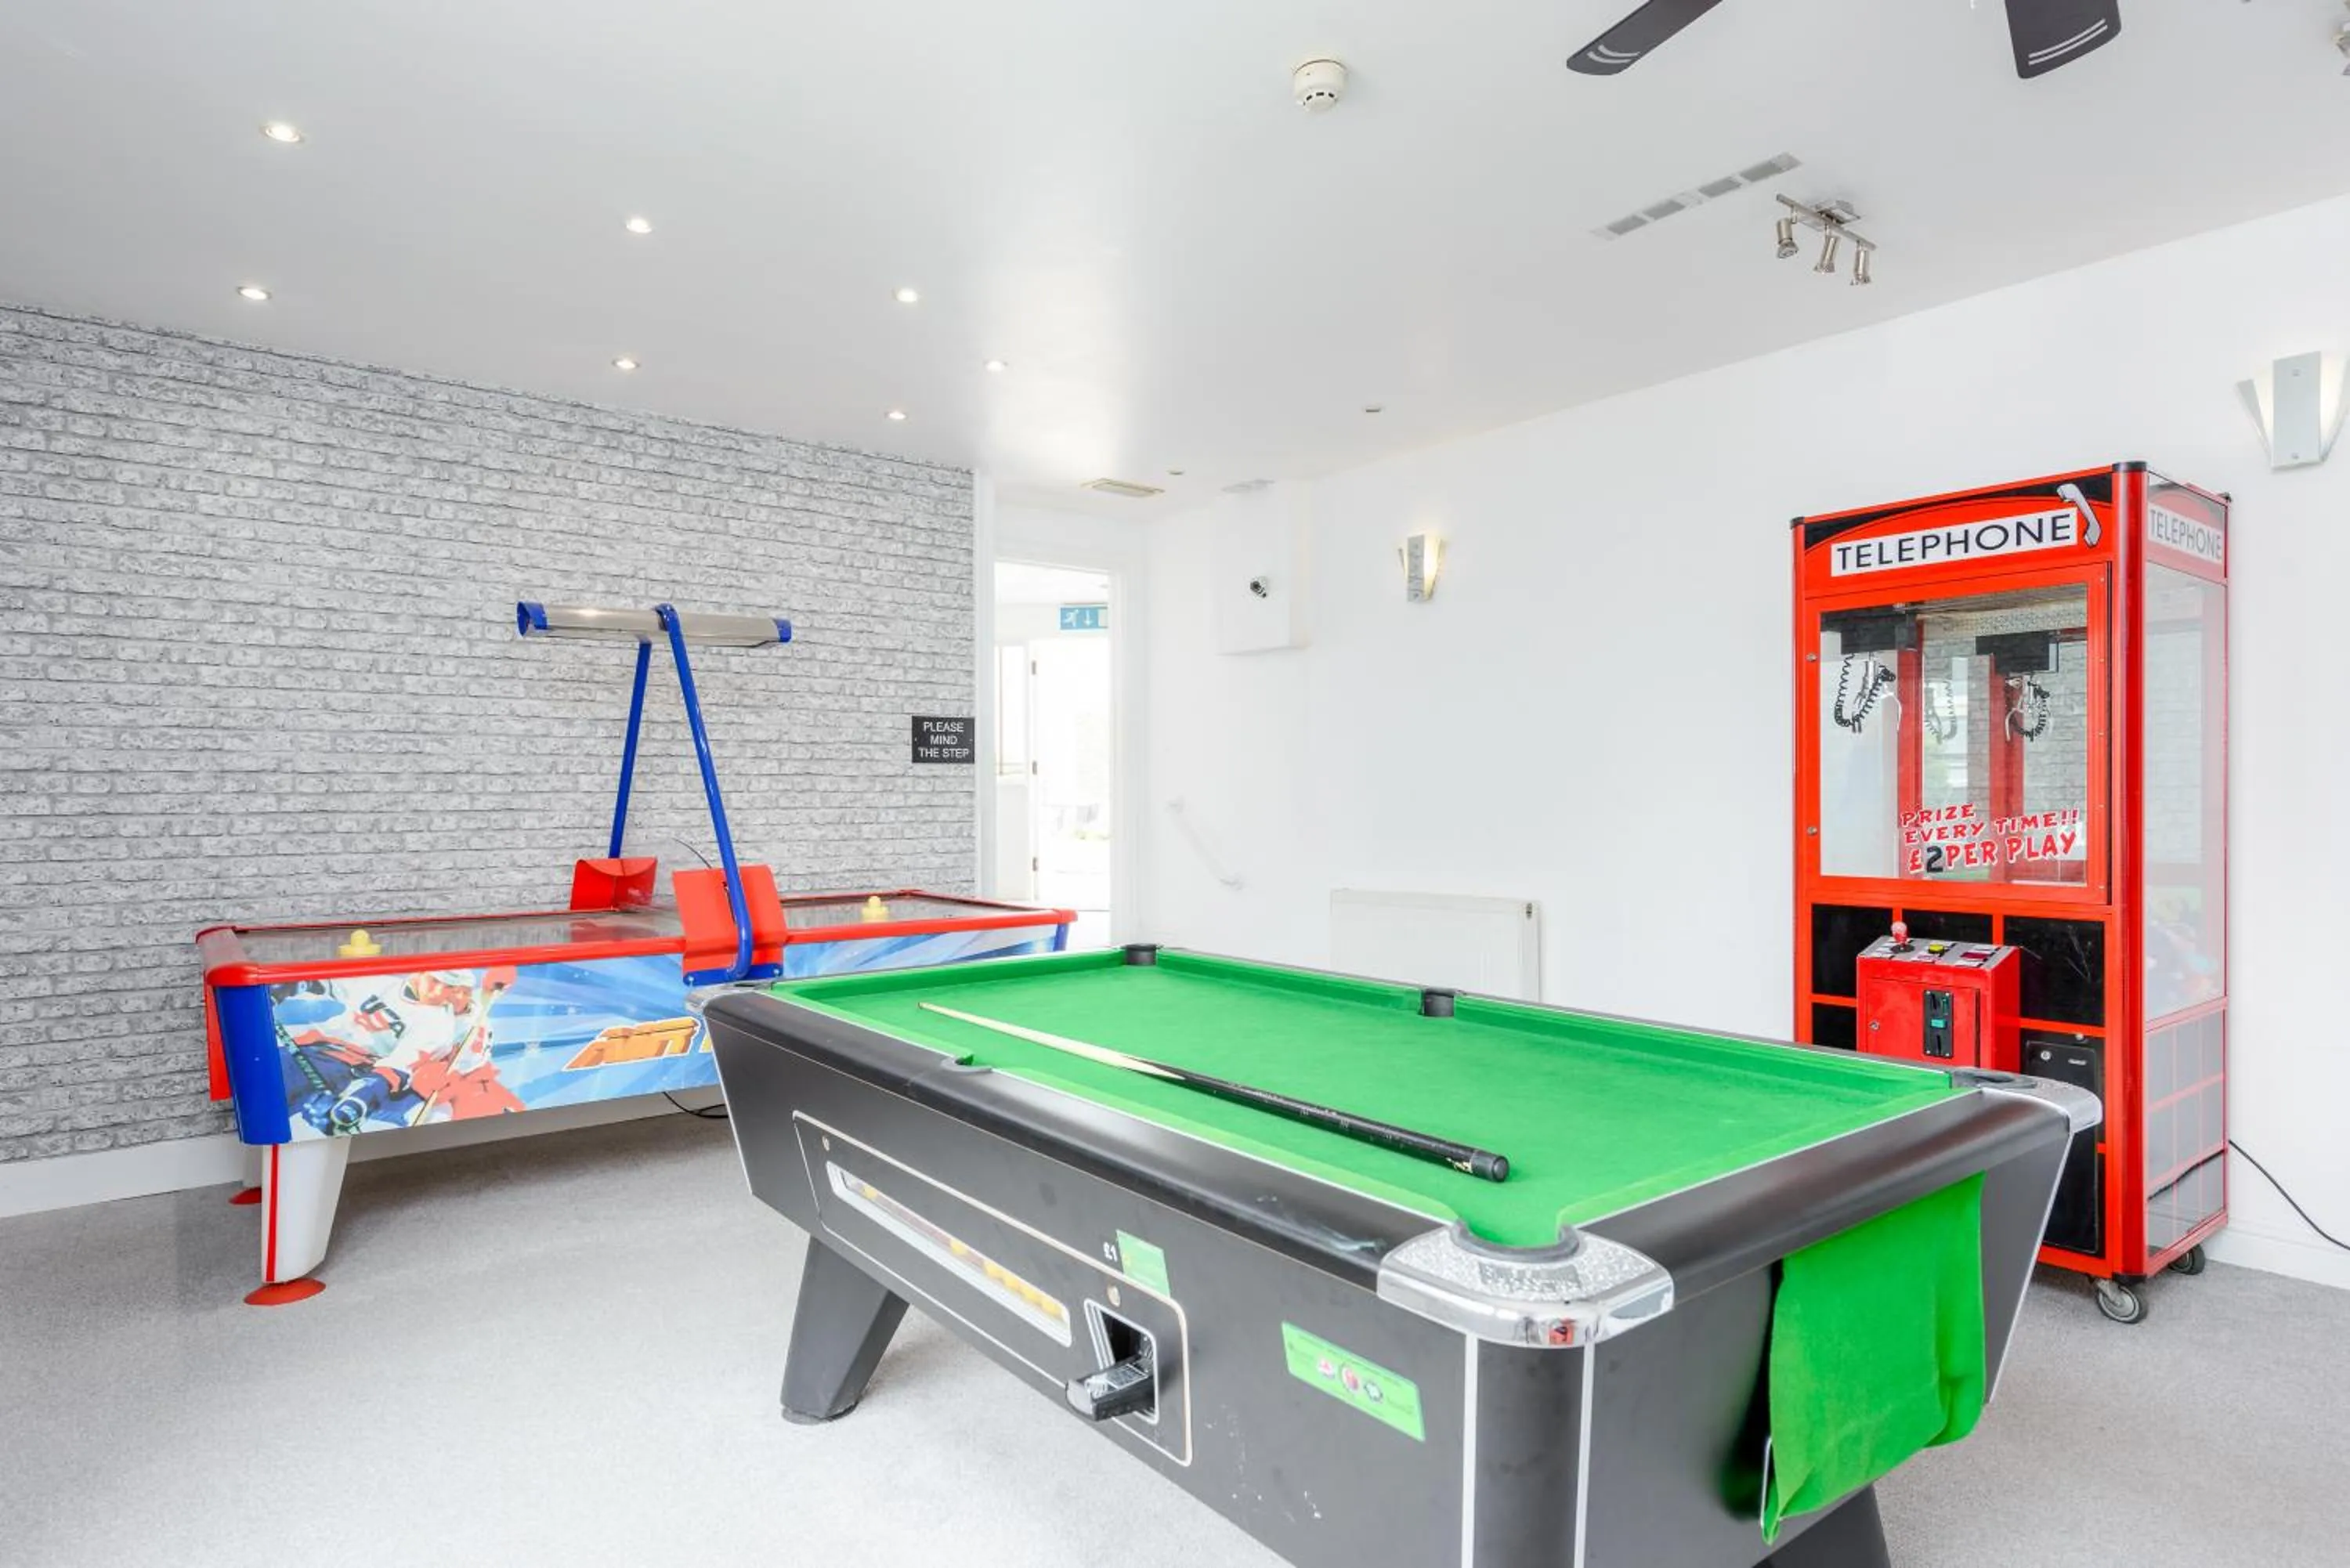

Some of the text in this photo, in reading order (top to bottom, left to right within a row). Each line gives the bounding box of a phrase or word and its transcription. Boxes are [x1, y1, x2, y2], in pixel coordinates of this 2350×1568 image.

[1837, 513, 2072, 571] TELEPHONE
[2149, 509, 2222, 561] TELEPHONE
[923, 721, 964, 732] PLEASE
[930, 735, 958, 745] MIND
[917, 746, 970, 759] THE STEP
[1901, 803, 1976, 828] PRIZE
[1904, 809, 2079, 844] EVERY TIME!!
[2005, 830, 2077, 862] PLAY
